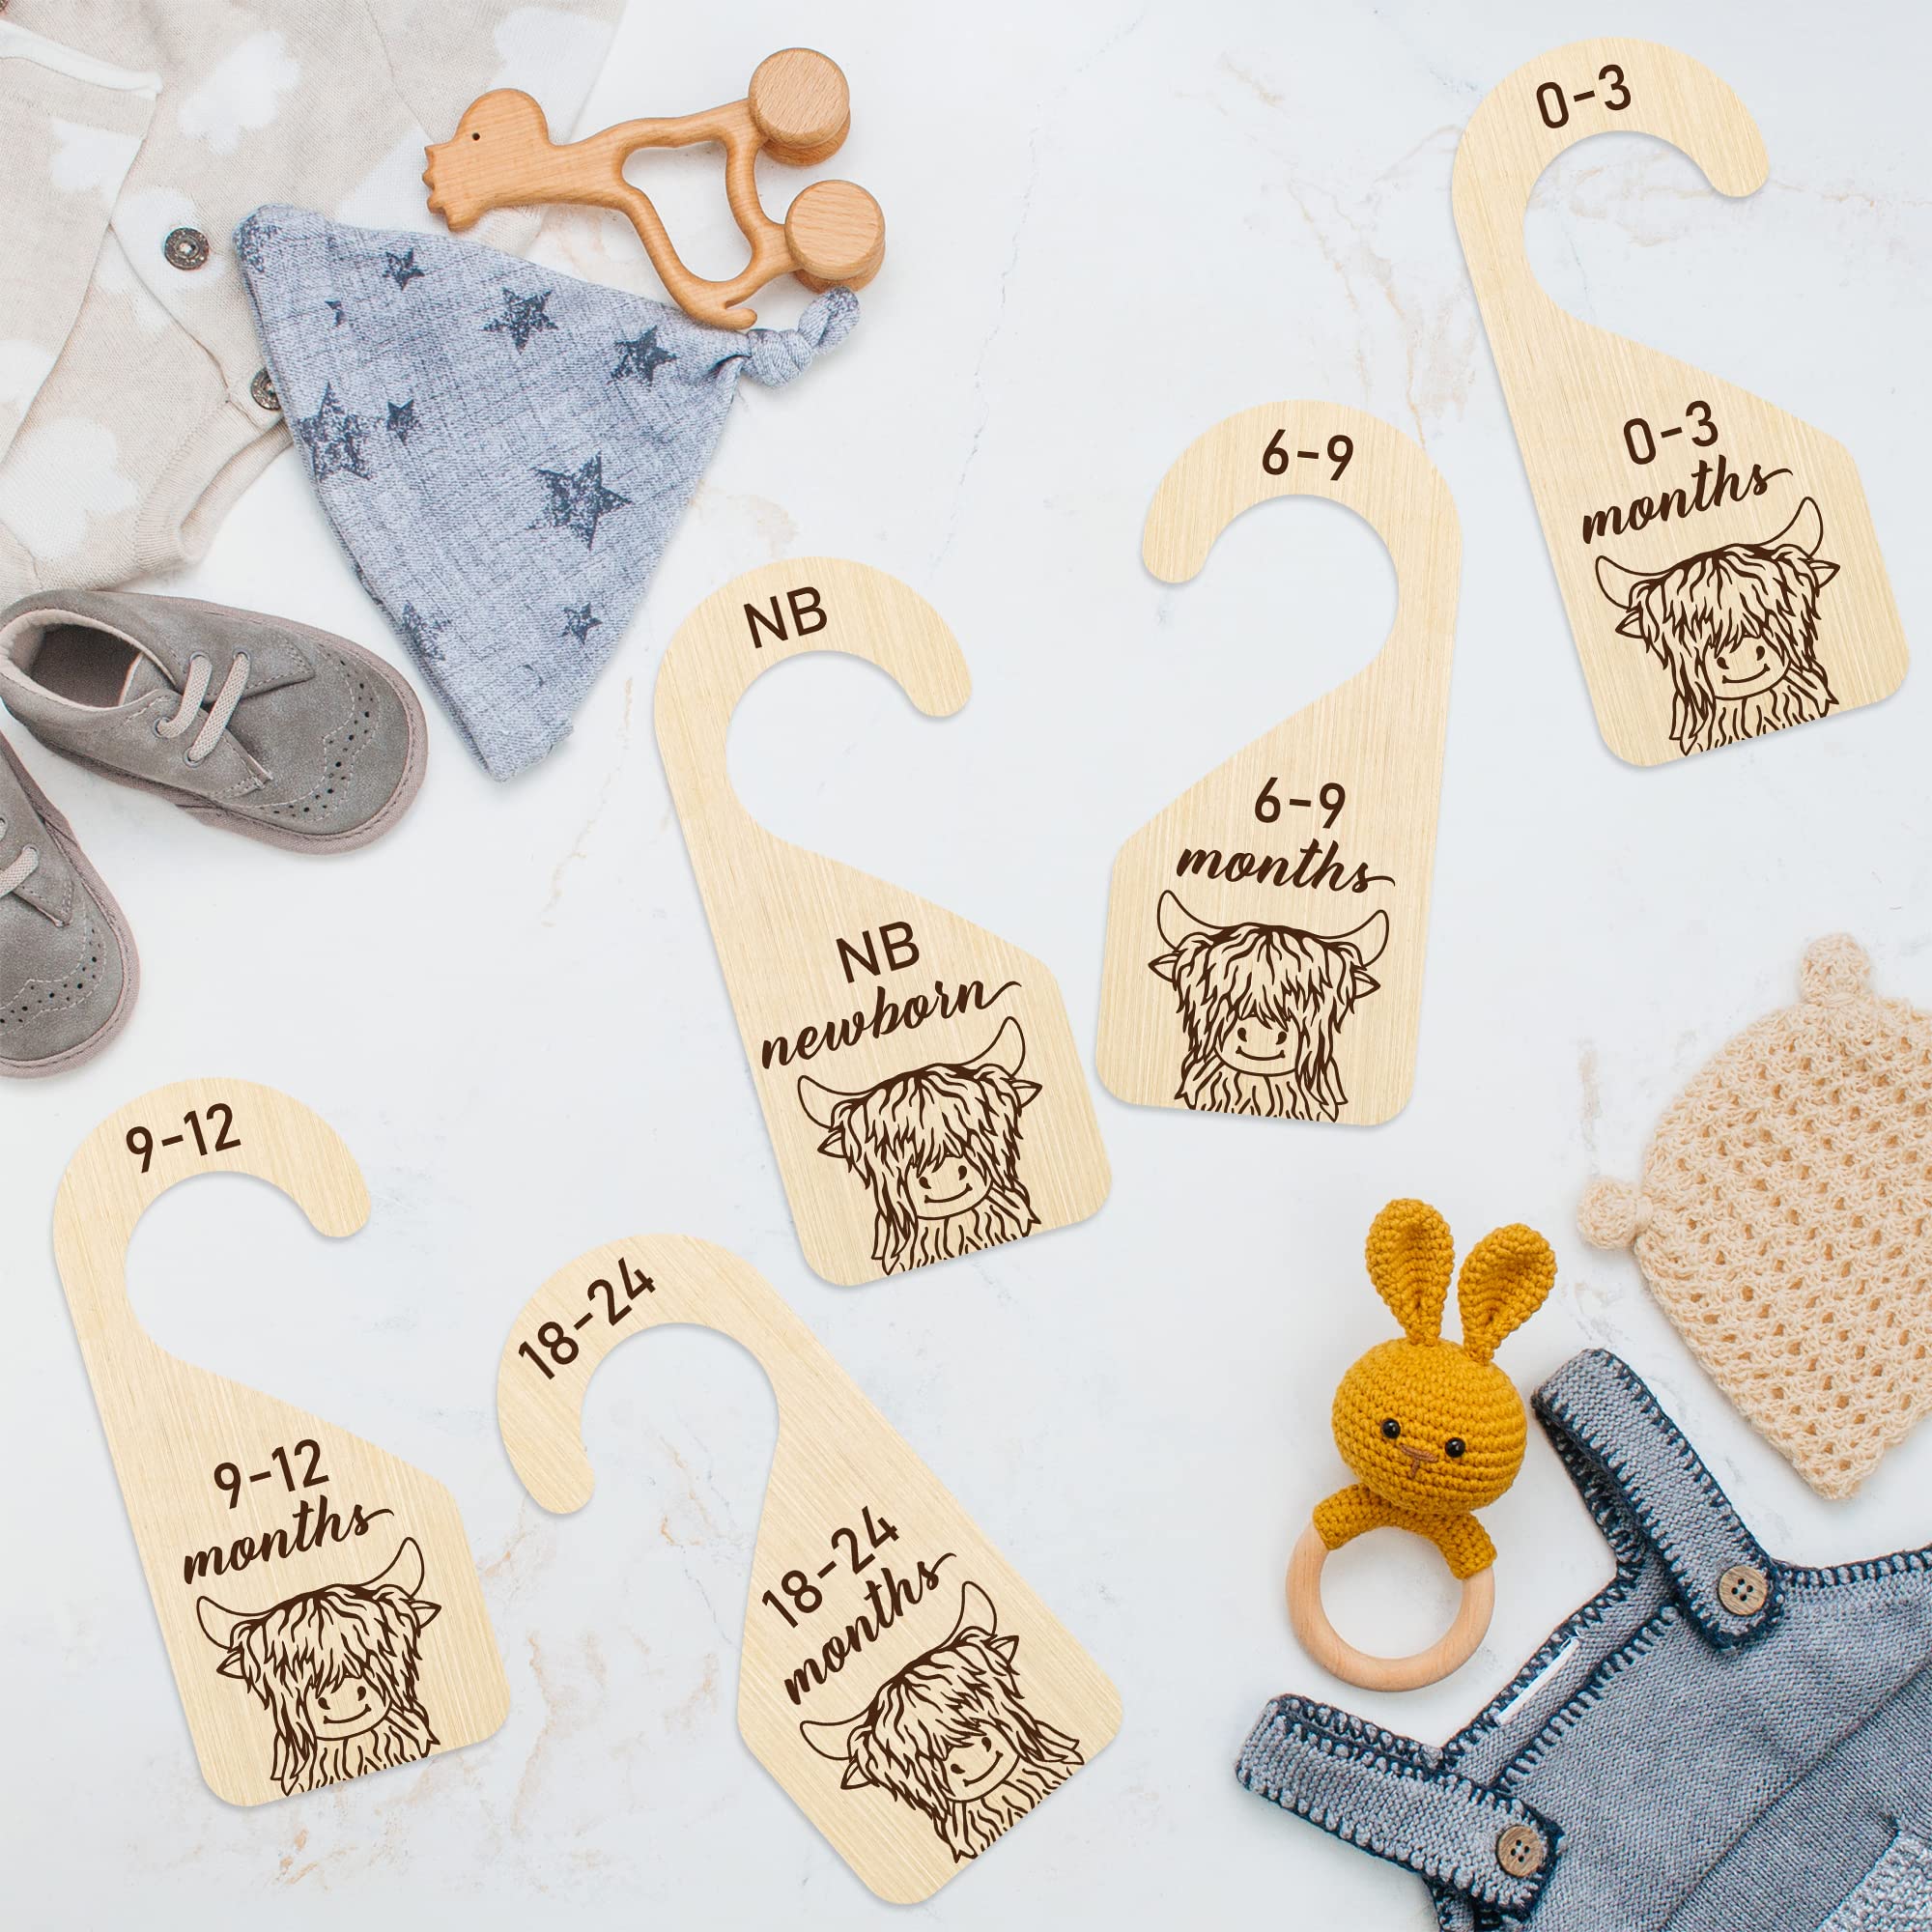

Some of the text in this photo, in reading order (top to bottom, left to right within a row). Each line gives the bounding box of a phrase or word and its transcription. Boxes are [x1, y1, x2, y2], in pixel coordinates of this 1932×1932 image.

[1537, 65, 1631, 128] 0-3
[1263, 429, 1353, 481] 6-9
[1624, 401, 1718, 465] 0-3
[1583, 455, 1793, 544] months
[744, 587, 827, 648] NB
[1255, 777, 1346, 829] 6-9
[1177, 838, 1395, 893] months
[837, 922, 919, 983] NB
[762, 980, 1021, 1069] newborn
[127, 1103, 242, 1173] 9-12
[519, 1258, 655, 1379] 18-24
[214, 1439, 329, 1509] 9-12
[185, 1494, 394, 1584] months
[762, 1506, 899, 1628] 18-24
[784, 1552, 956, 1705] months
